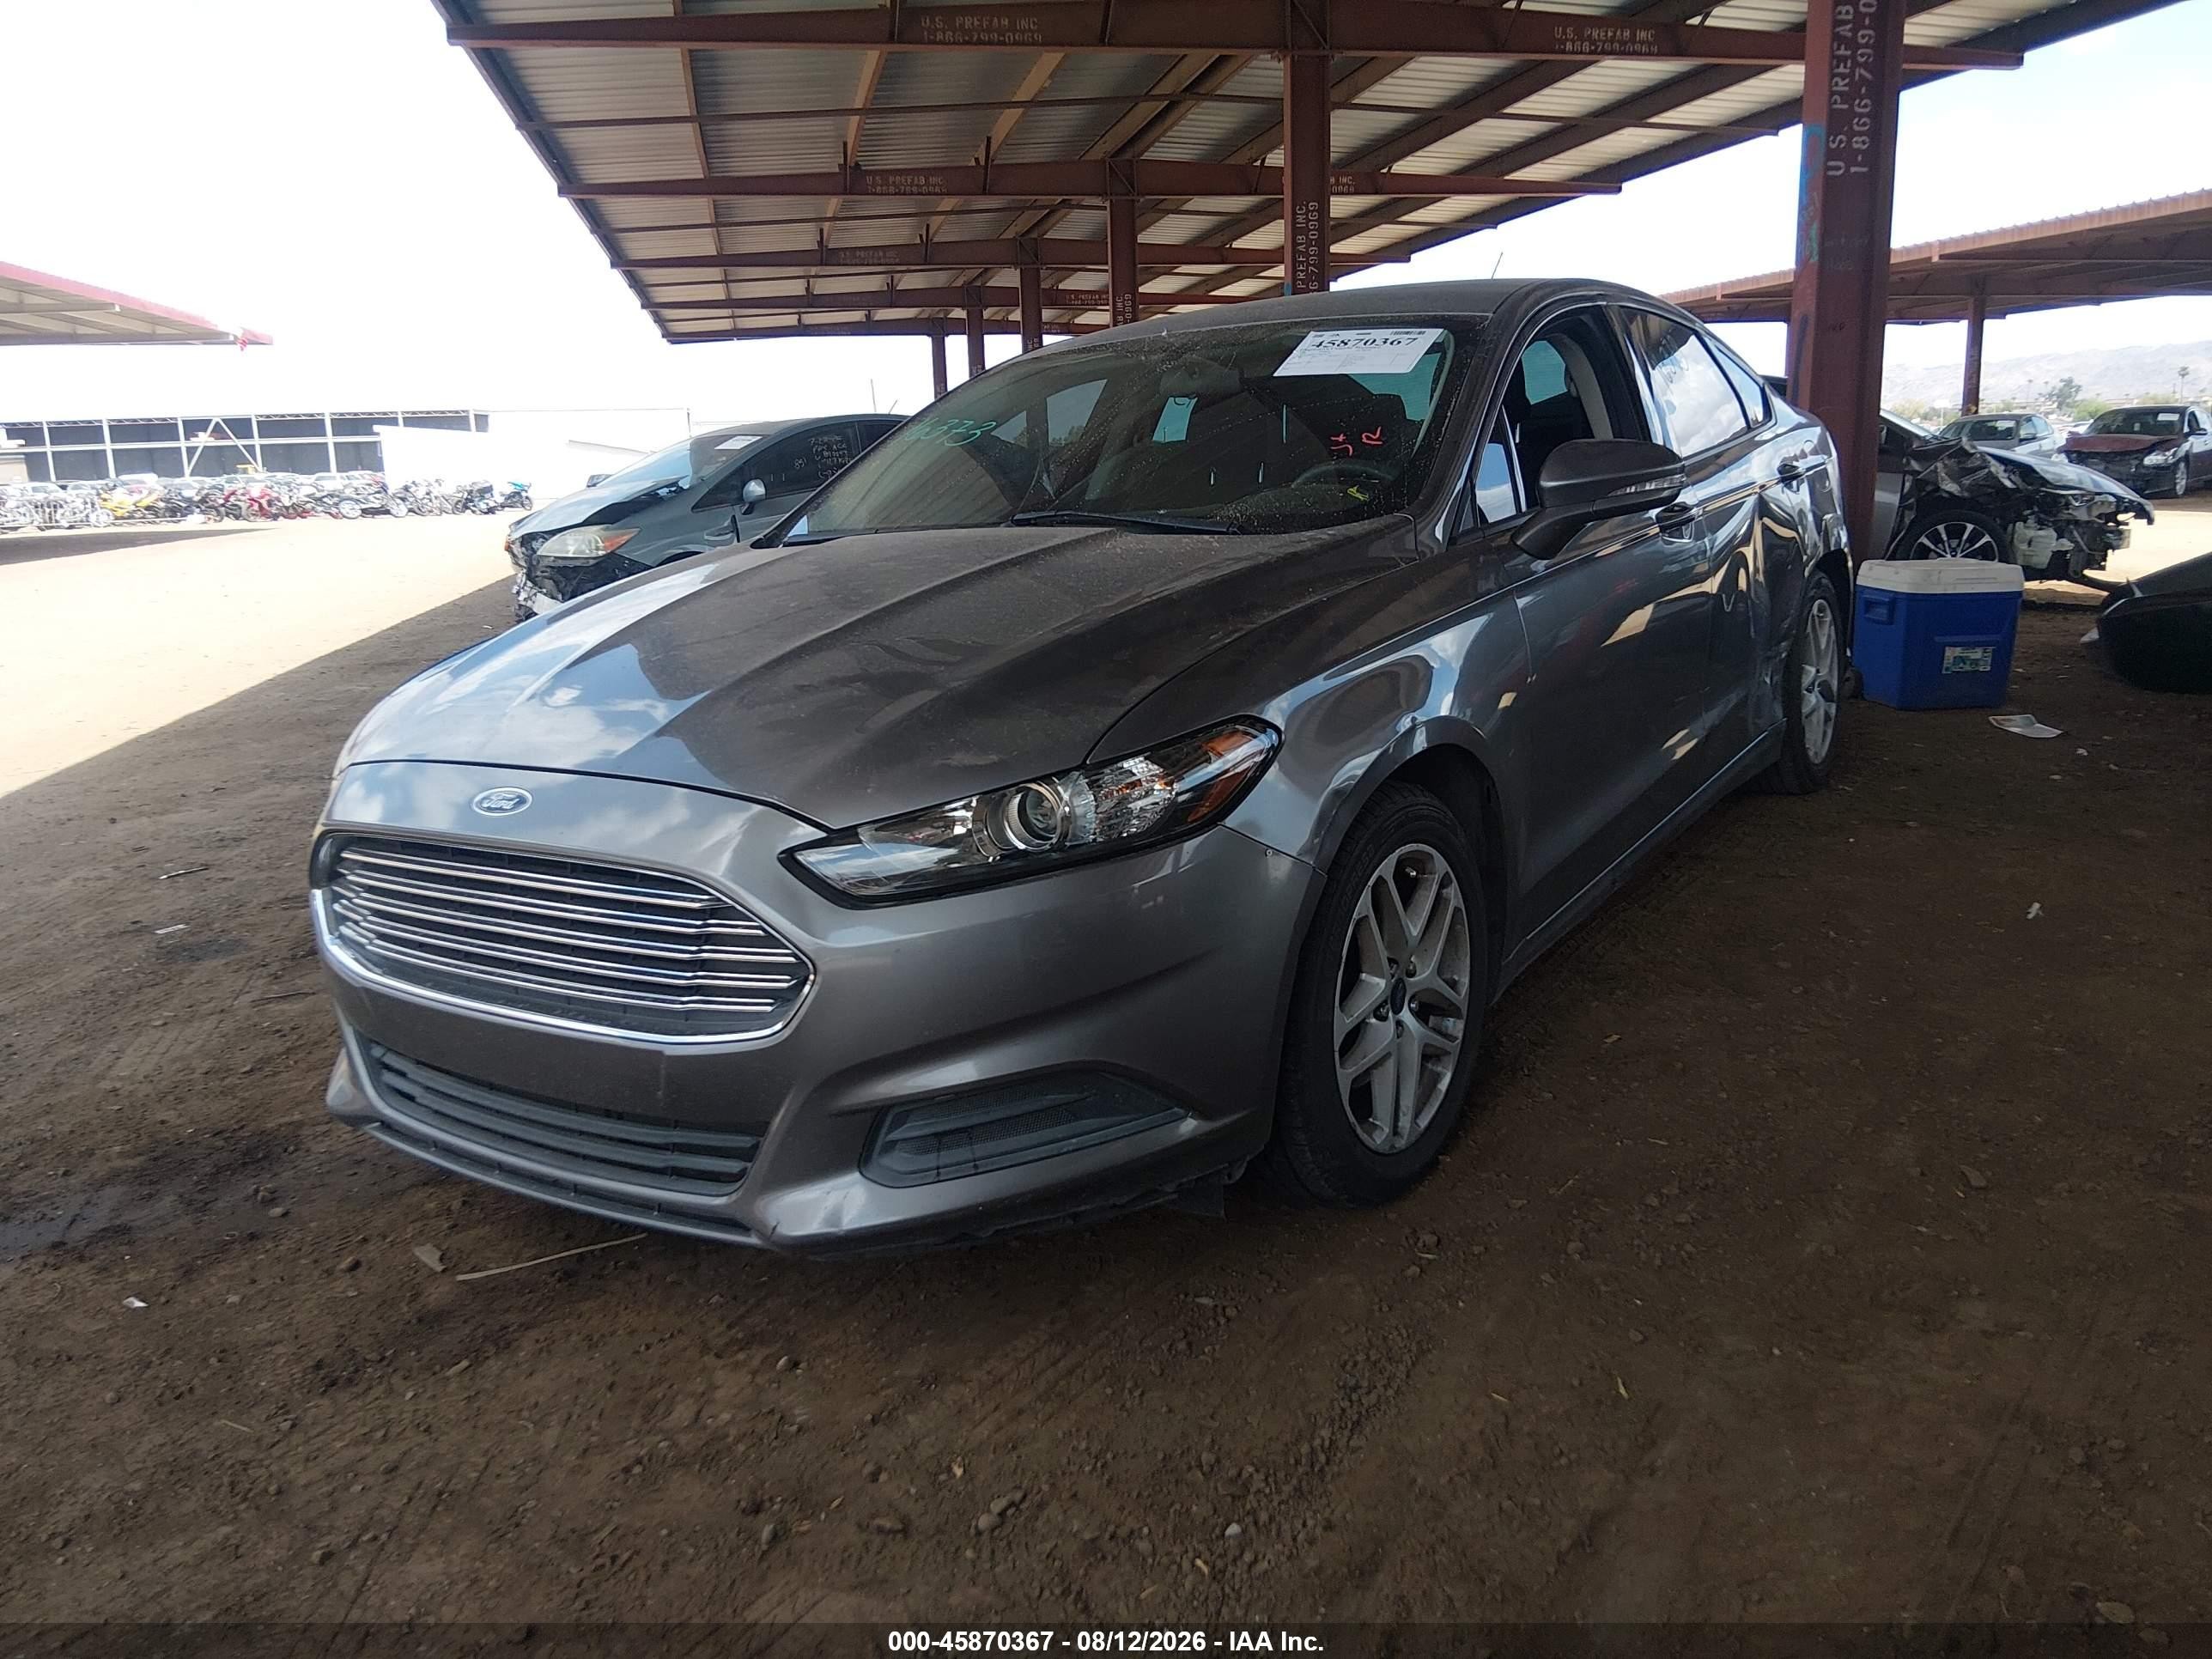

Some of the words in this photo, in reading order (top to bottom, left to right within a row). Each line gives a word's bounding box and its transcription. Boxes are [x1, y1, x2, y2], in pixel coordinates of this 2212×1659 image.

[955, 15, 1010, 30] PREFAB
[1583, 27, 1631, 41] PREFAB
[1831, 4, 1854, 110] PREFAB
[1295, 200, 1307, 228] INC.
[1308, 202, 1319, 294] 6-799-0969
[1296, 234, 1307, 289] PREFAB
[1311, 337, 1419, 349] 45870367
[481, 793, 520, 810] Ford
